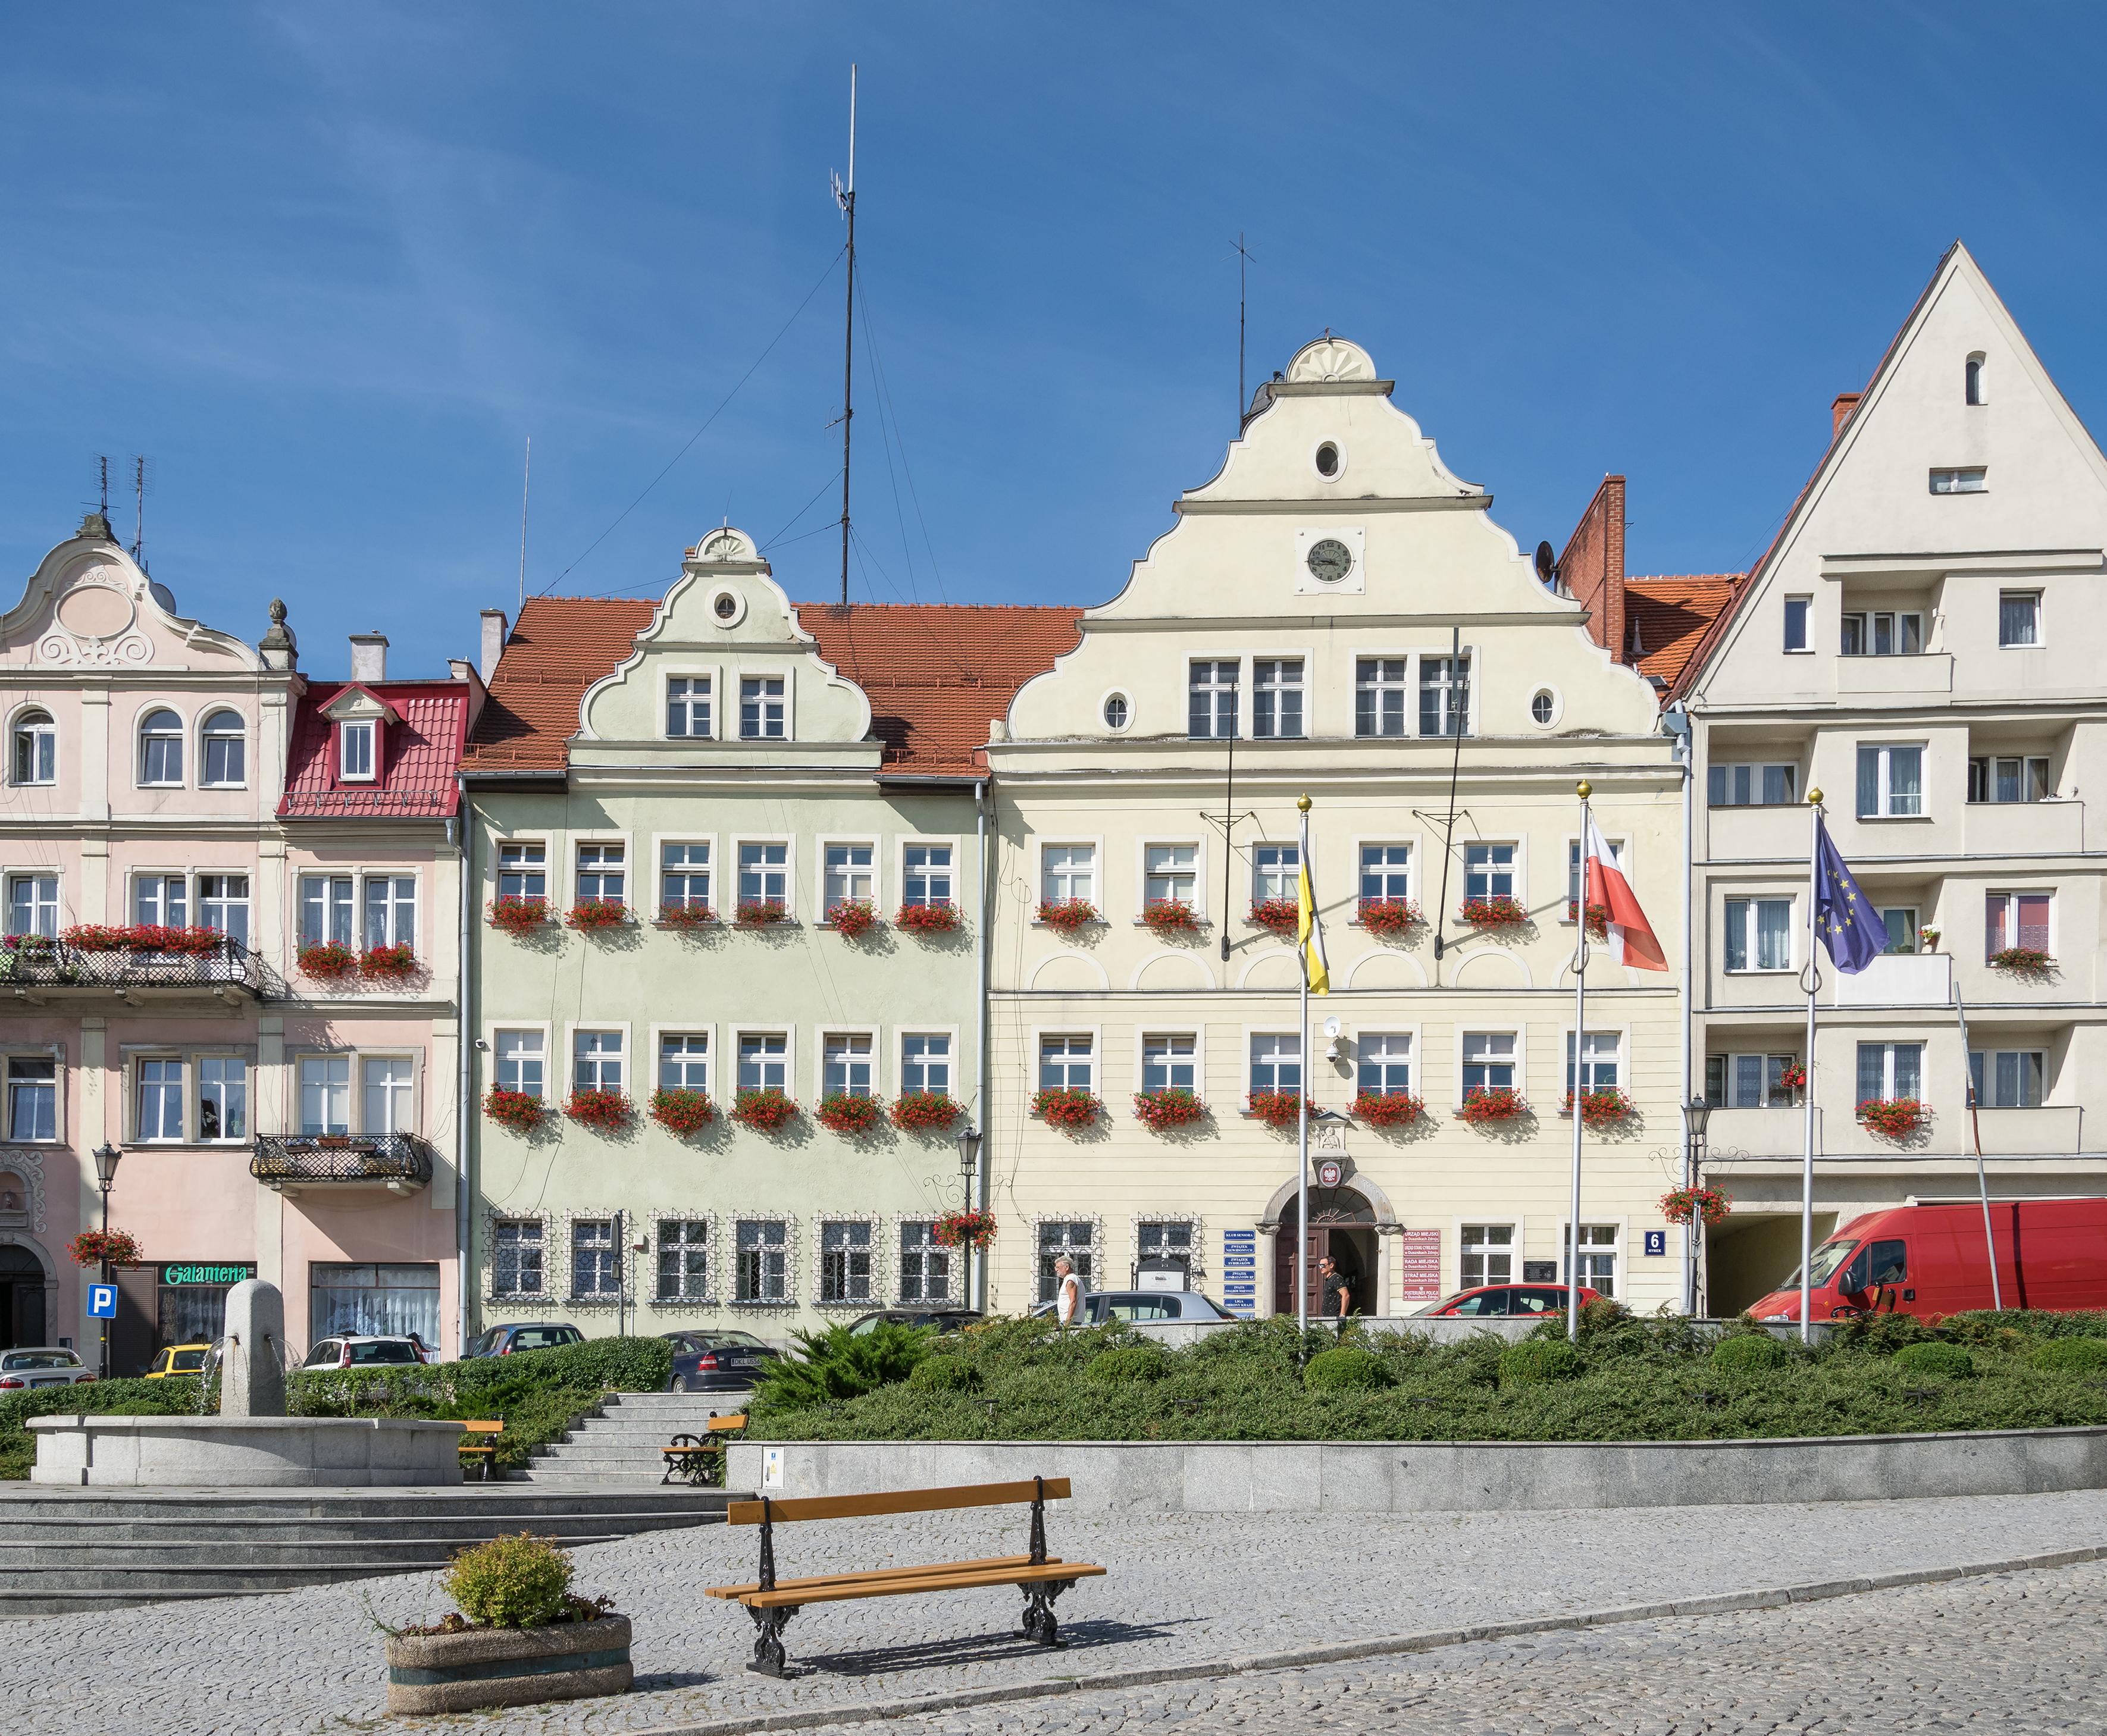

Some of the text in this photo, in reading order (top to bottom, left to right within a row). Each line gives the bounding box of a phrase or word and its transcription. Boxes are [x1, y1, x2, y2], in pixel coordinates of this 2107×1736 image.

[1651, 1234, 1659, 1248] 6
[165, 1263, 247, 1285] Galanteria
[94, 1288, 111, 1313] P
